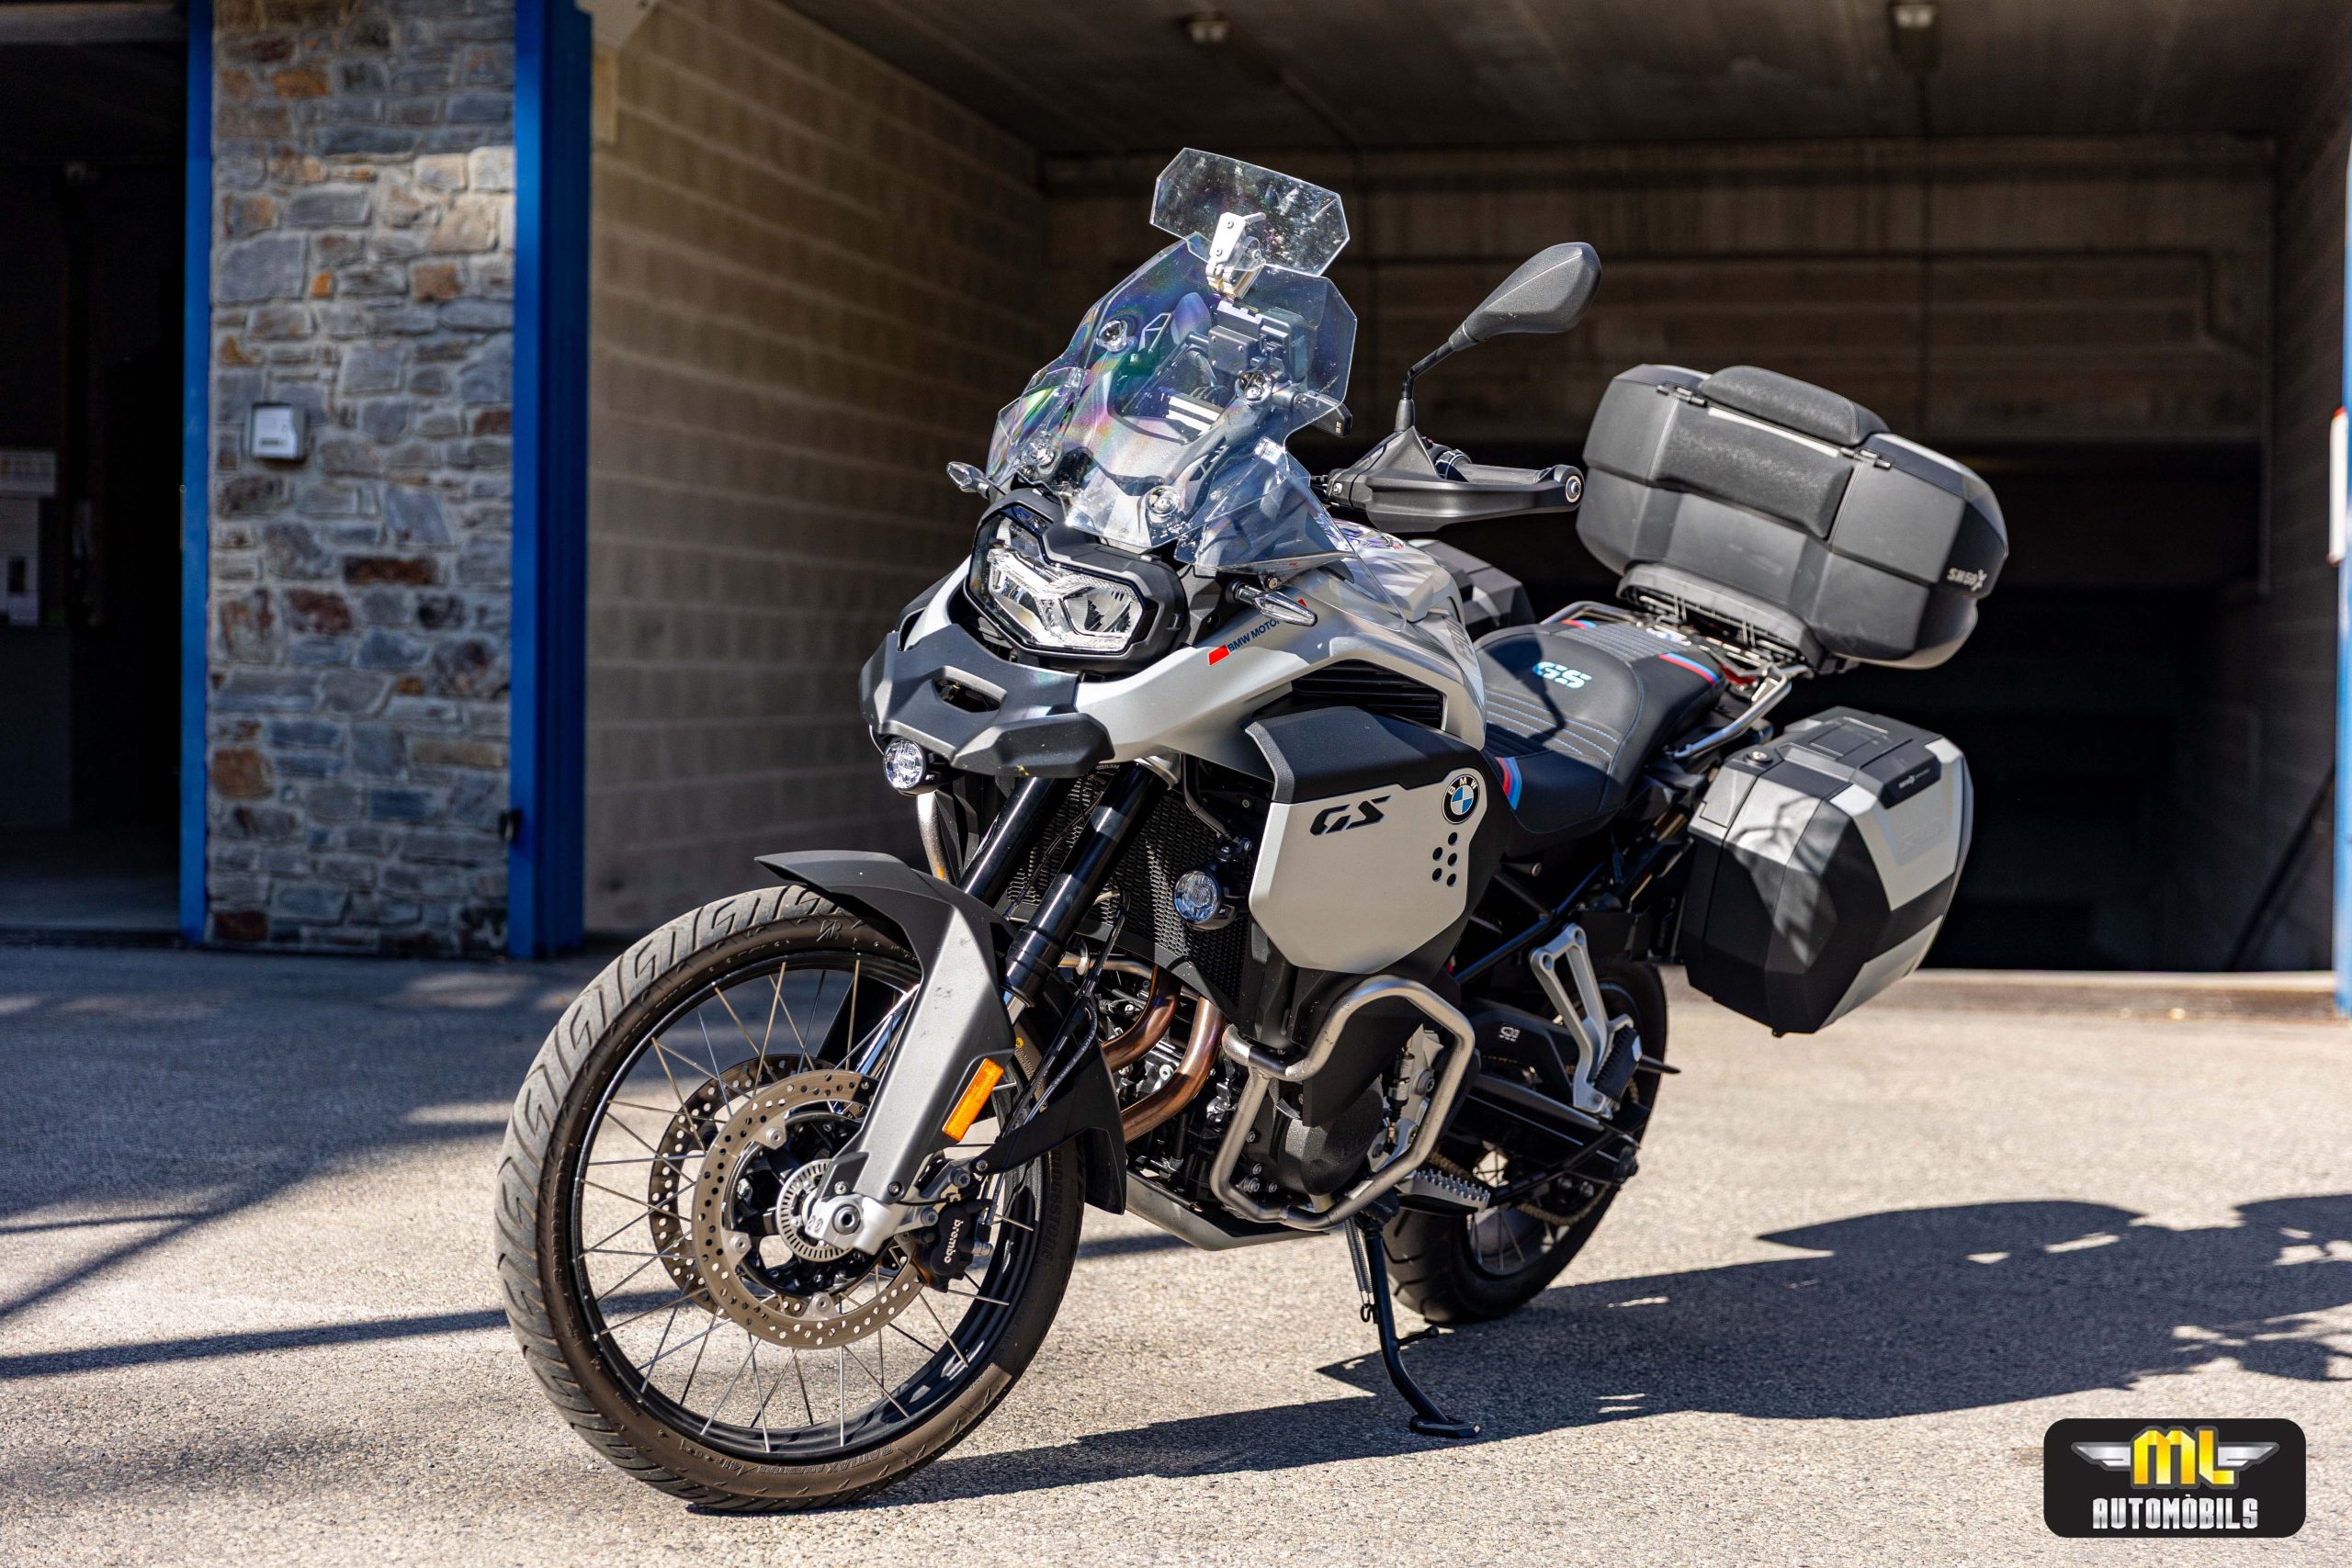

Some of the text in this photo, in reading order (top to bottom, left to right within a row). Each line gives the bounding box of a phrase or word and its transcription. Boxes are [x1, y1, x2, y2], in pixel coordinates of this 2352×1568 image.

[1227, 619, 1280, 652] BMW MOTO
[1532, 660, 1593, 689] GS
[1309, 795, 1392, 836] GS
[1041, 1149, 1063, 1261] RIDGESTONE
[944, 1219, 964, 1263] brembo
